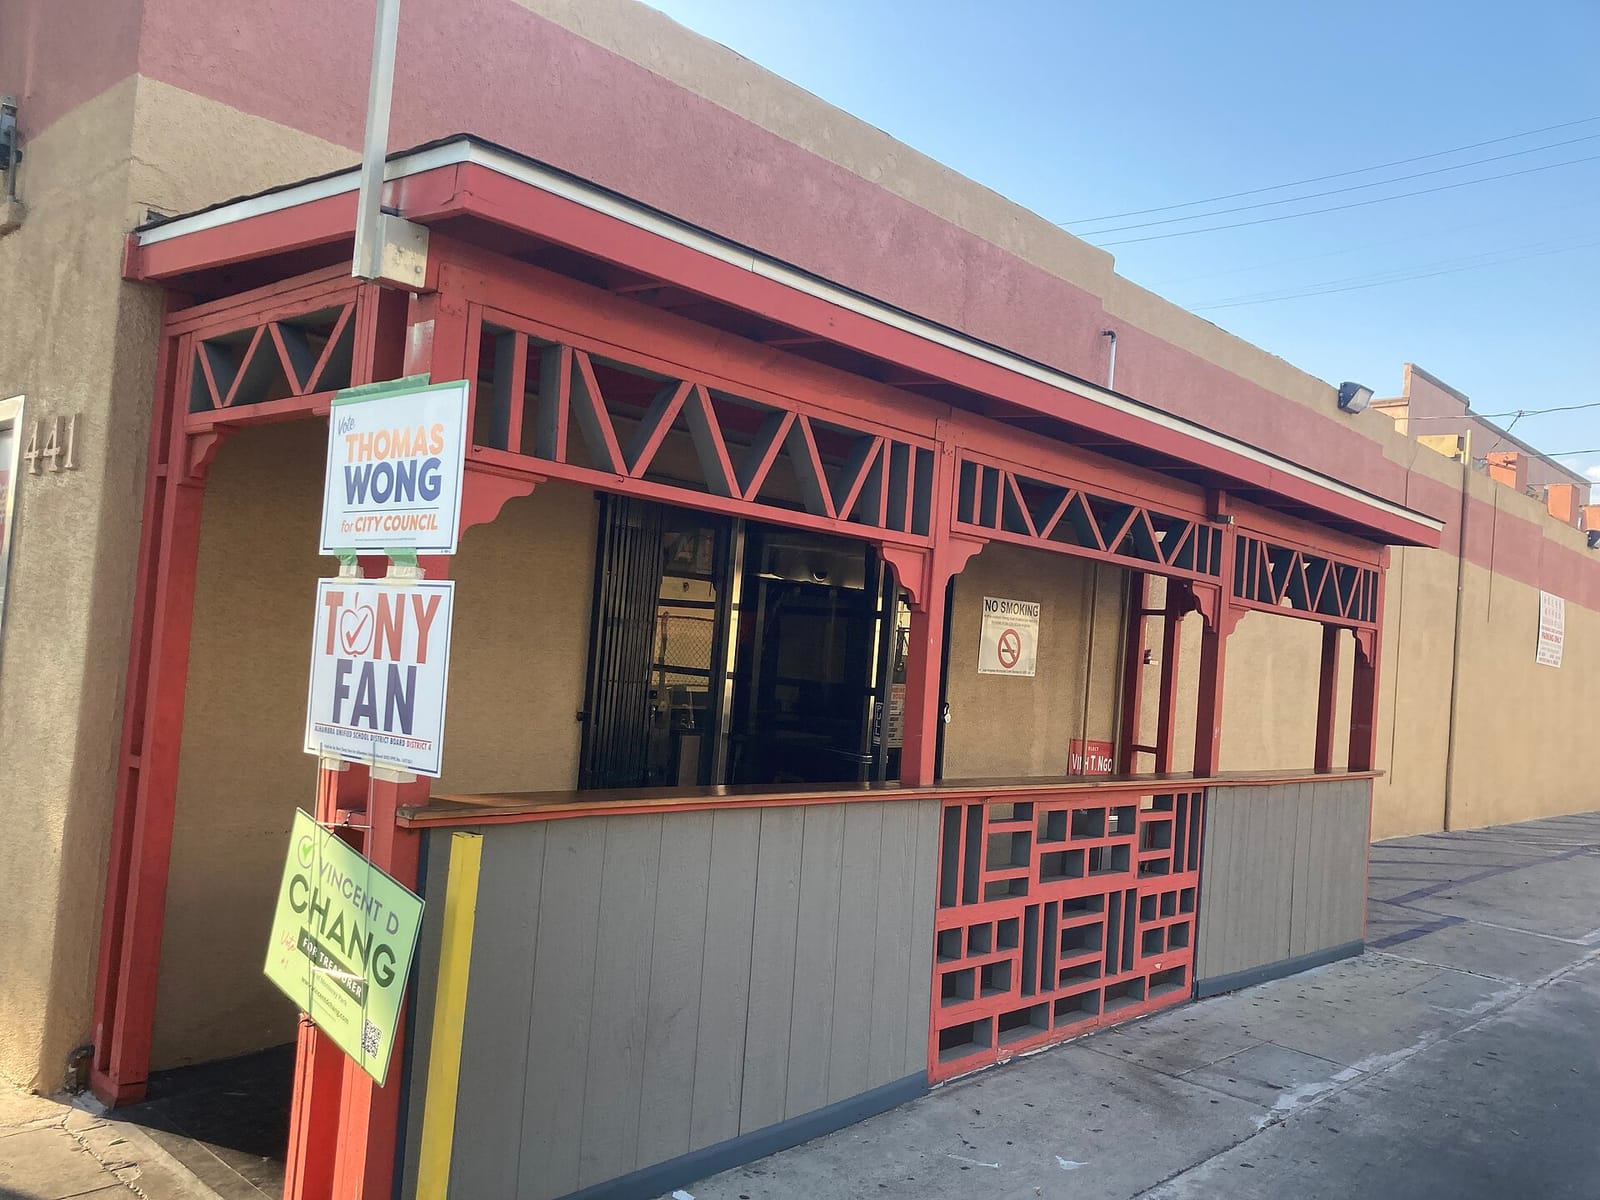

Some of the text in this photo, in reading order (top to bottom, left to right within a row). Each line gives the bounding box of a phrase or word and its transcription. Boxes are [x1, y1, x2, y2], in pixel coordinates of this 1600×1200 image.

[24, 414, 76, 475] 441
[338, 416, 356, 436] Vote
[345, 423, 445, 463] THOMAS
[344, 457, 442, 505] WONG
[340, 514, 438, 533] for CITY COUNCIL
[324, 591, 443, 665] TONY
[985, 600, 1039, 617] NO SMOKING
[332, 658, 417, 736] FAN
[353, 731, 369, 741] SCHOOL
[370, 734, 389, 744] DISTRICT
[406, 740, 427, 750] DISTRICT
[319, 857, 399, 935] VINCENT D
[289, 874, 396, 988] CHANG
[302, 937, 318, 958] FOR
